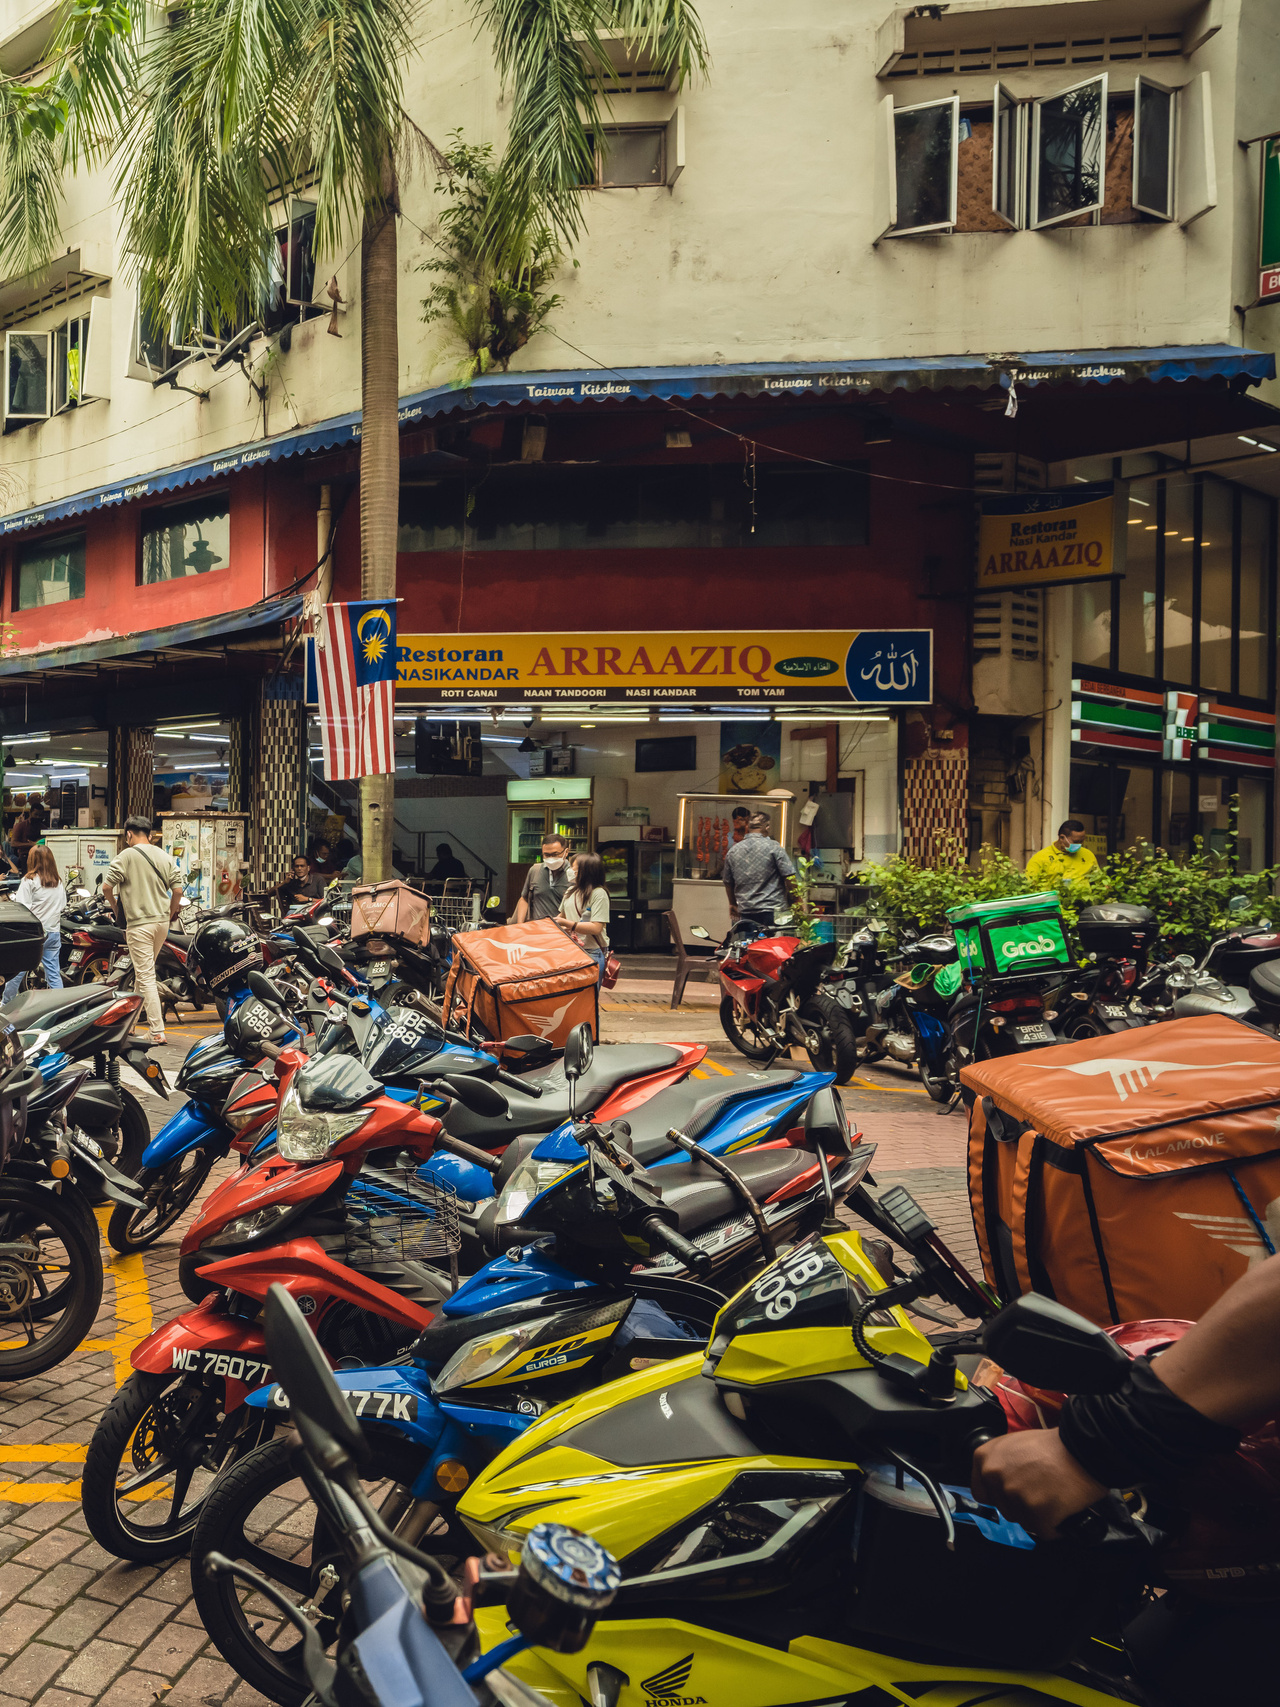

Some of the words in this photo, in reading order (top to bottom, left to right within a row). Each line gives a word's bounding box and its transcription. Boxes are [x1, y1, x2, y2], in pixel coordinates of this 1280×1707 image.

[527, 385, 575, 398] Taiwan
[580, 382, 631, 396] Kitchen
[762, 377, 814, 390] Taiwan
[212, 456, 239, 472] Taiwan
[241, 448, 270, 464] Kitchen
[124, 483, 149, 497] Kitchen
[1011, 519, 1077, 537] Restoran
[1010, 536, 1033, 547] Nasi
[1036, 531, 1077, 544] Kandar
[983, 541, 1103, 577] ARRAAZIQ
[398, 646, 504, 663] Restoran
[526, 645, 772, 683] ARRAAZIQ
[395, 667, 519, 681] NASIKANDAR
[441, 690, 464, 698] ROTI
[467, 690, 498, 698] CANAI
[523, 689, 552, 697] NAAN
[555, 689, 606, 697] TANDOORI
[625, 689, 650, 697] NASI
[653, 688, 697, 697] KANDAR
[737, 688, 760, 697] TOM
[763, 688, 785, 696] YAM
[1001, 935, 1056, 958] Grab
[251, 1003, 277, 1025] BQJ
[398, 1008, 433, 1035] VBE
[241, 1012, 273, 1038] 7856
[383, 1022, 422, 1049] 8881
[1023, 1032, 1048, 1041] 4316
[1135, 1132, 1226, 1161] LALAMOVE
[172, 1347, 200, 1371] WC
[203, 1354, 272, 1384] 7607T
[525, 1354, 568, 1372] EURO3
[645, 1697, 708, 1707] HONDA
